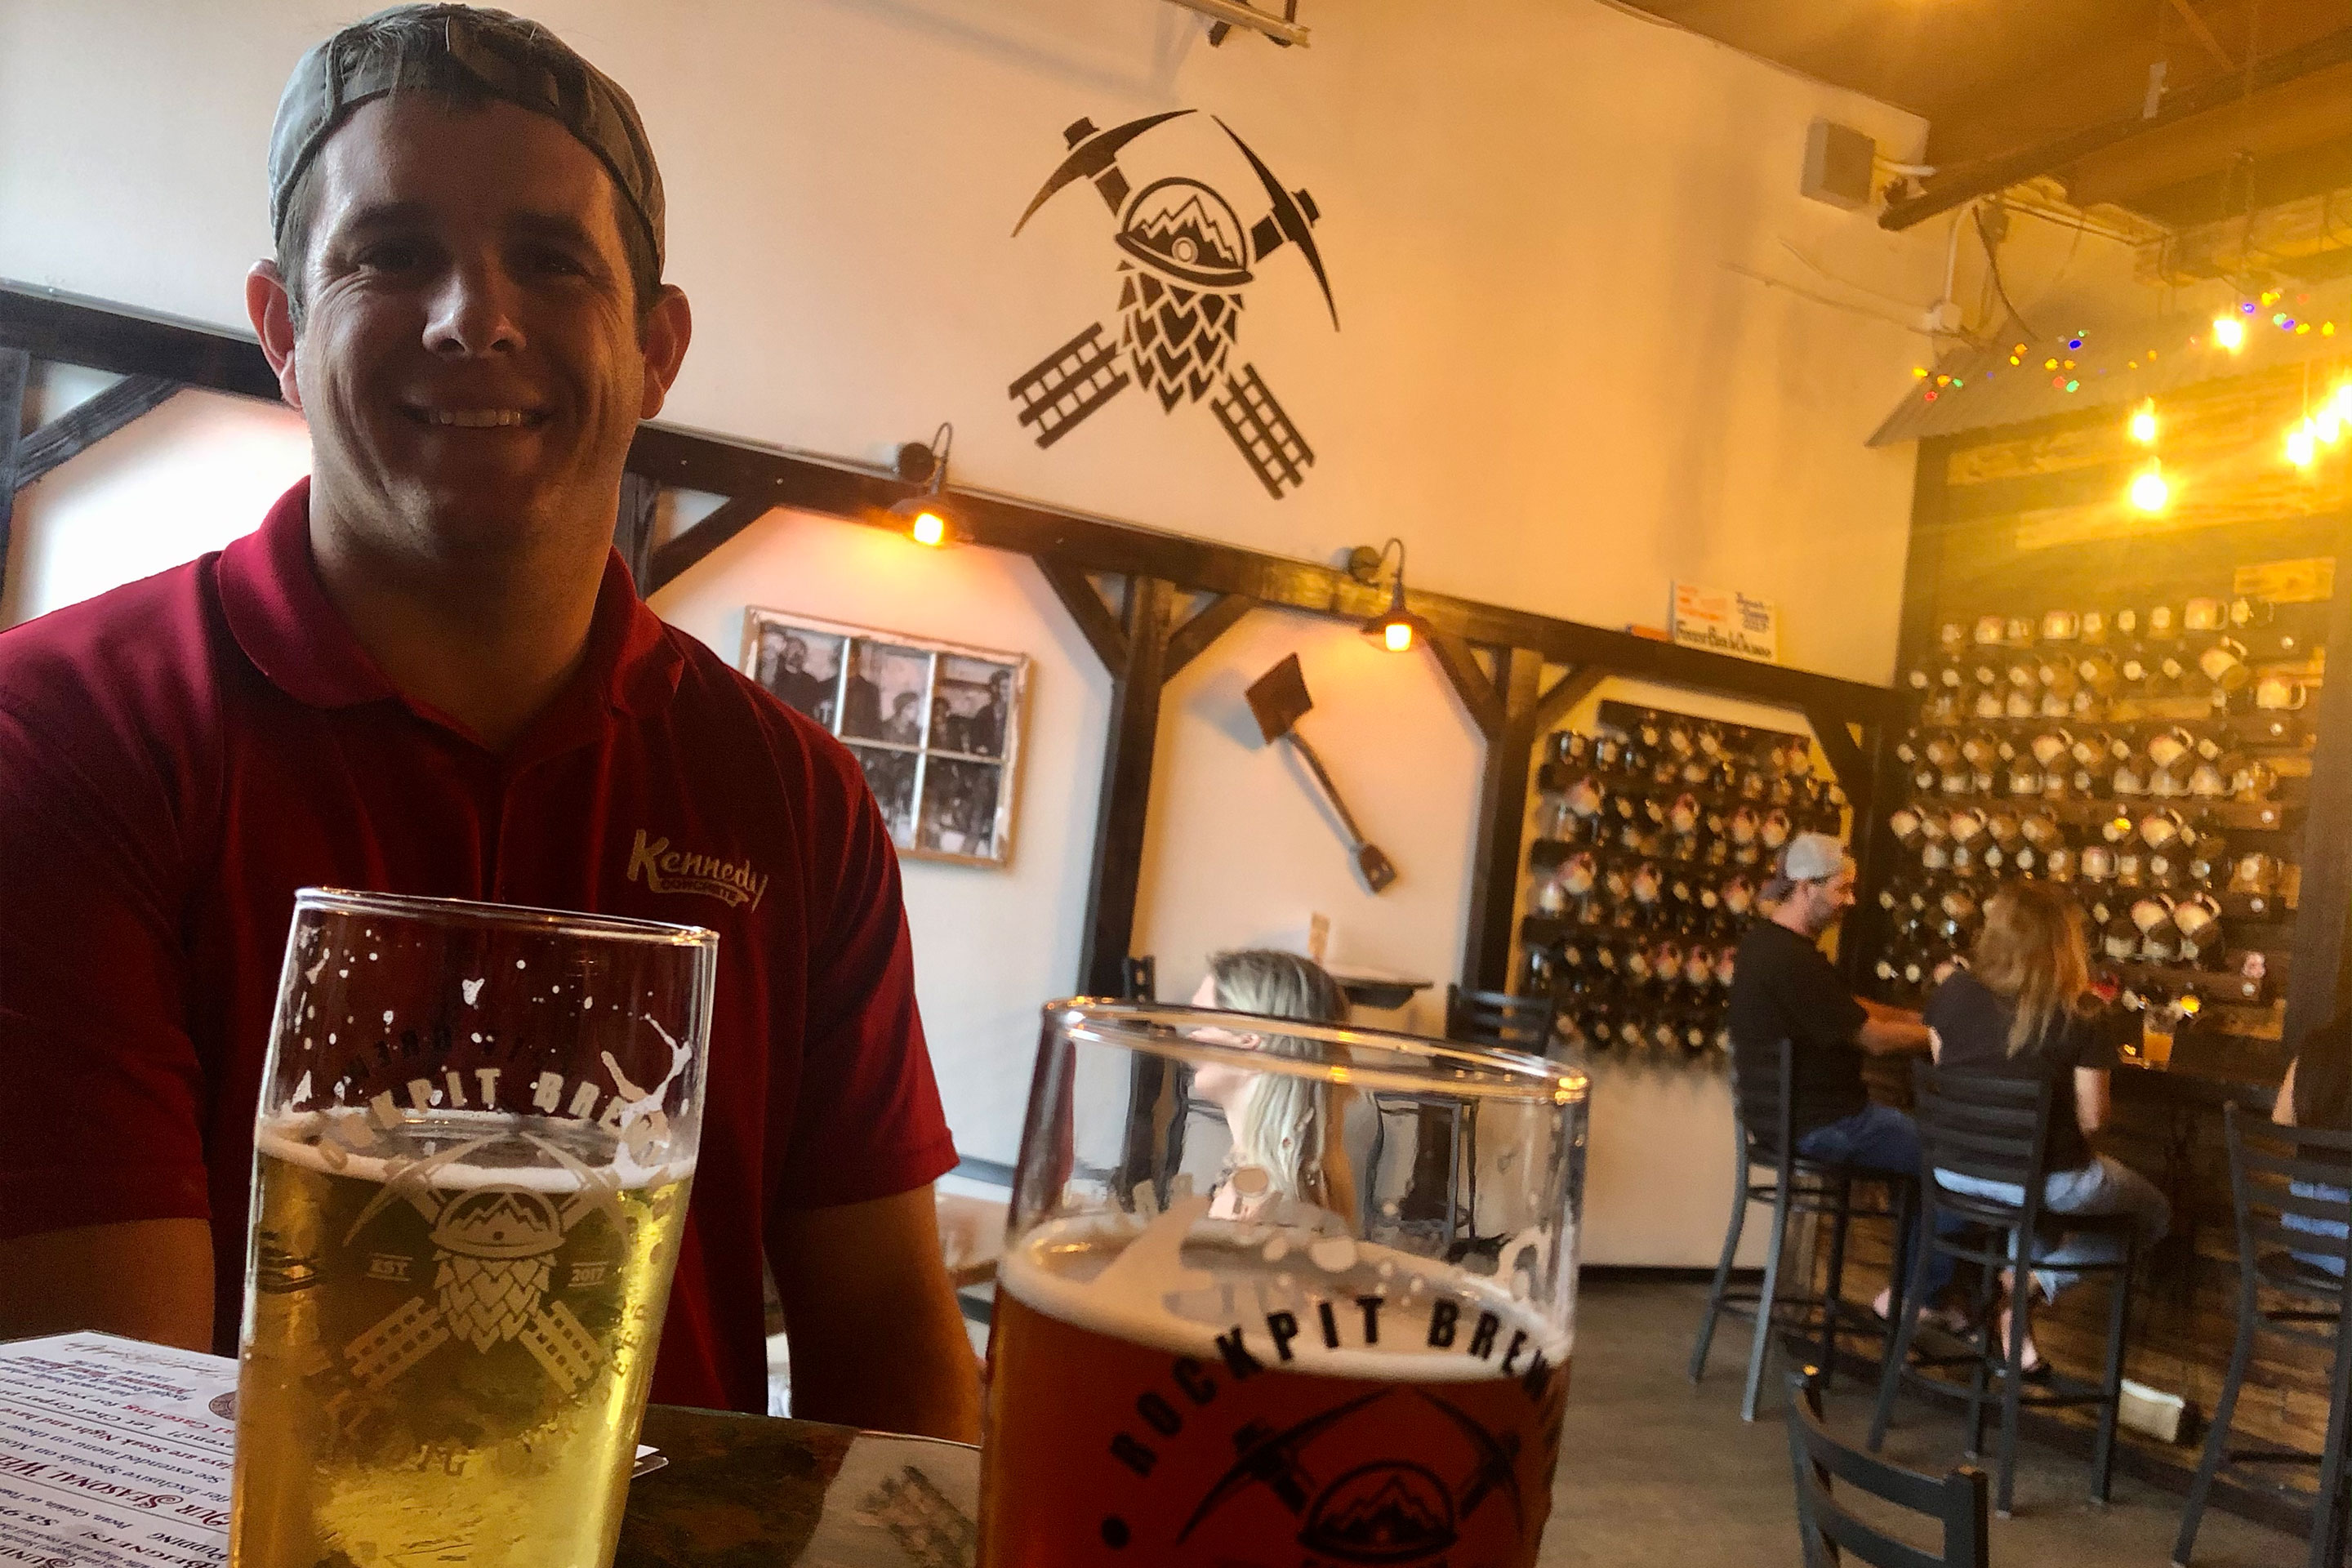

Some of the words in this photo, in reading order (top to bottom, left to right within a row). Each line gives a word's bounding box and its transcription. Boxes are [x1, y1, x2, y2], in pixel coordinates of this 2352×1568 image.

[627, 830, 768, 913] Kennedy
[47, 1388, 96, 1399] your
[1110, 1295, 1384, 1477] ROCKPIT
[90, 1398, 120, 1406] for
[73, 1408, 122, 1421] Chef
[120, 1404, 210, 1429] Catering
[35, 1418, 73, 1428] and
[124, 1420, 158, 1431] Let
[7, 1425, 50, 1437] those
[71, 1426, 122, 1441] Night
[50, 1435, 73, 1444] on
[120, 1438, 168, 1453] Steak
[34, 1447, 57, 1456] on
[73, 1441, 120, 1456] menu
[168, 1450, 198, 1459] are
[57, 1454, 122, 1475] Specials
[115, 1454, 194, 1474] extended
[122, 1471, 201, 1494] Exclusive
[194, 1473, 225, 1484] See
[47, 1469, 184, 1509] SEASONAL
[146, 1532, 229, 1561] PUDDING
